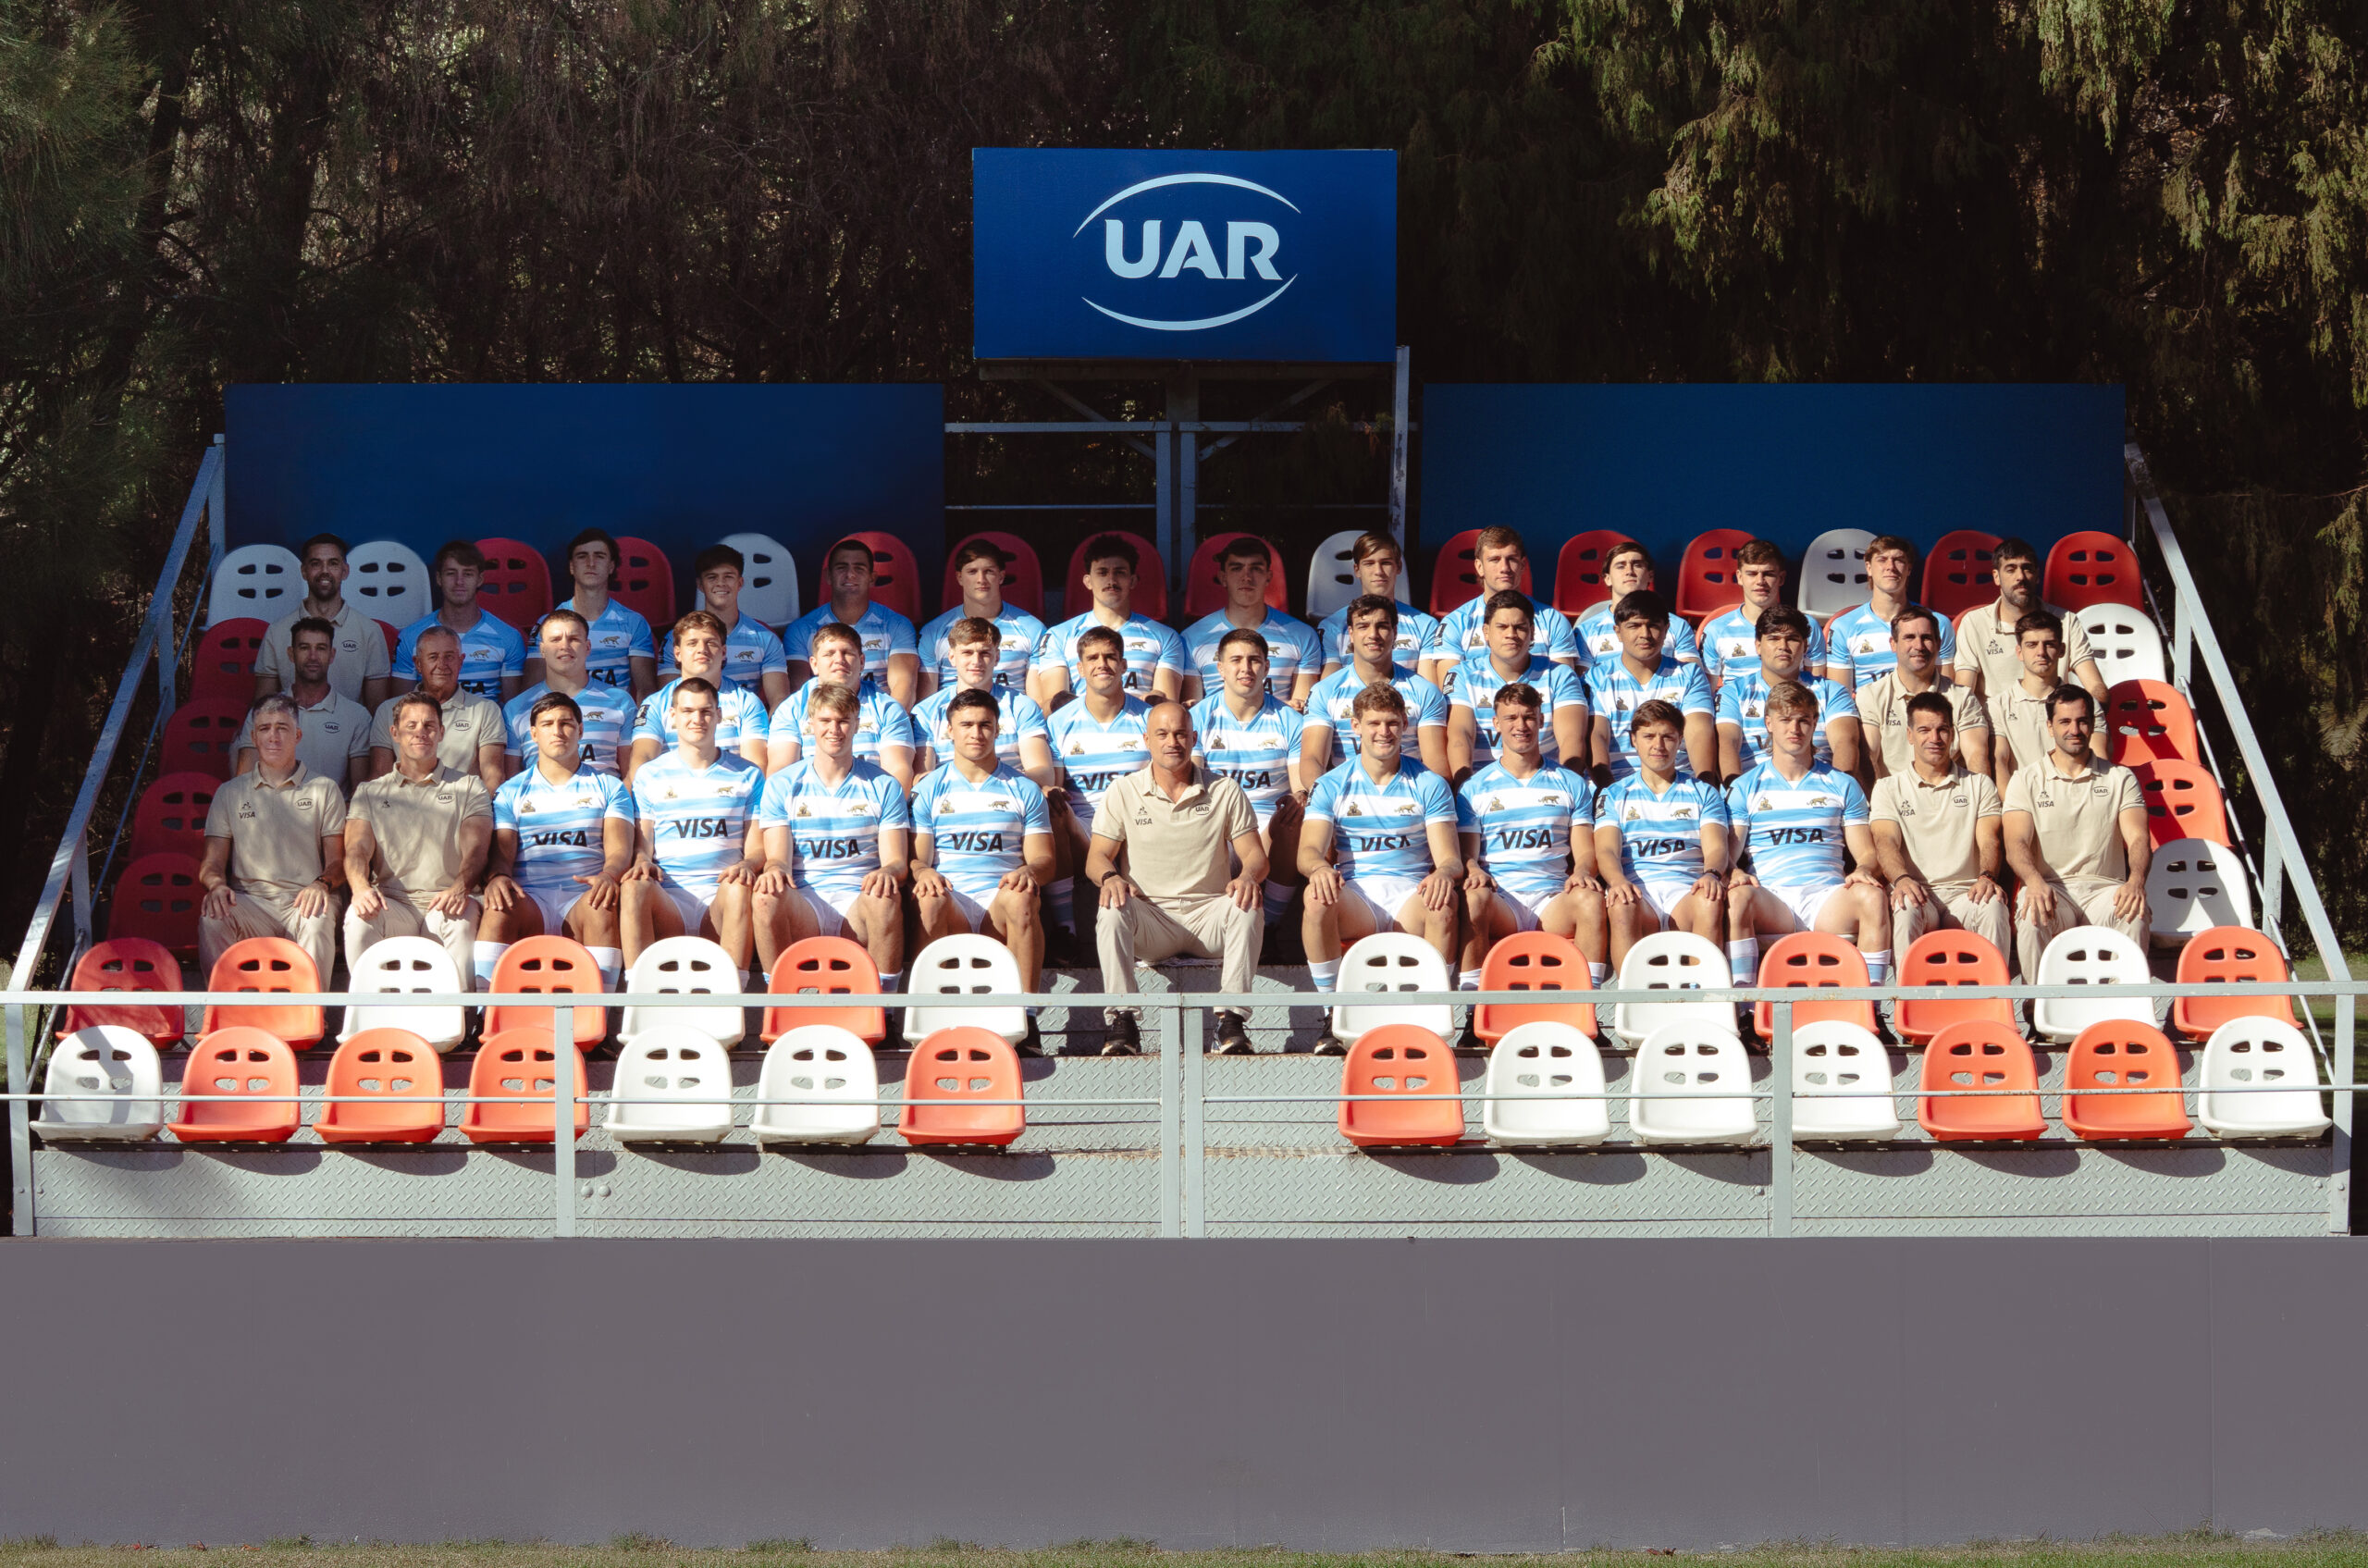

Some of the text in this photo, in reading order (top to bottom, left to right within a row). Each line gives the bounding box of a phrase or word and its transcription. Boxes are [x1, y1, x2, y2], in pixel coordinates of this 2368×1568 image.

[1105, 219, 1282, 279] UAR
[239, 811, 255, 820] VISA
[1135, 818, 1153, 826] VISA
[1898, 809, 1916, 817] VISA
[673, 818, 728, 838] VISA
[1768, 828, 1824, 846] VISA
[805, 839, 861, 858] VISA
[948, 833, 1003, 852] VISA
[1497, 829, 1552, 849] VISA
[1634, 838, 1685, 858] VISA
